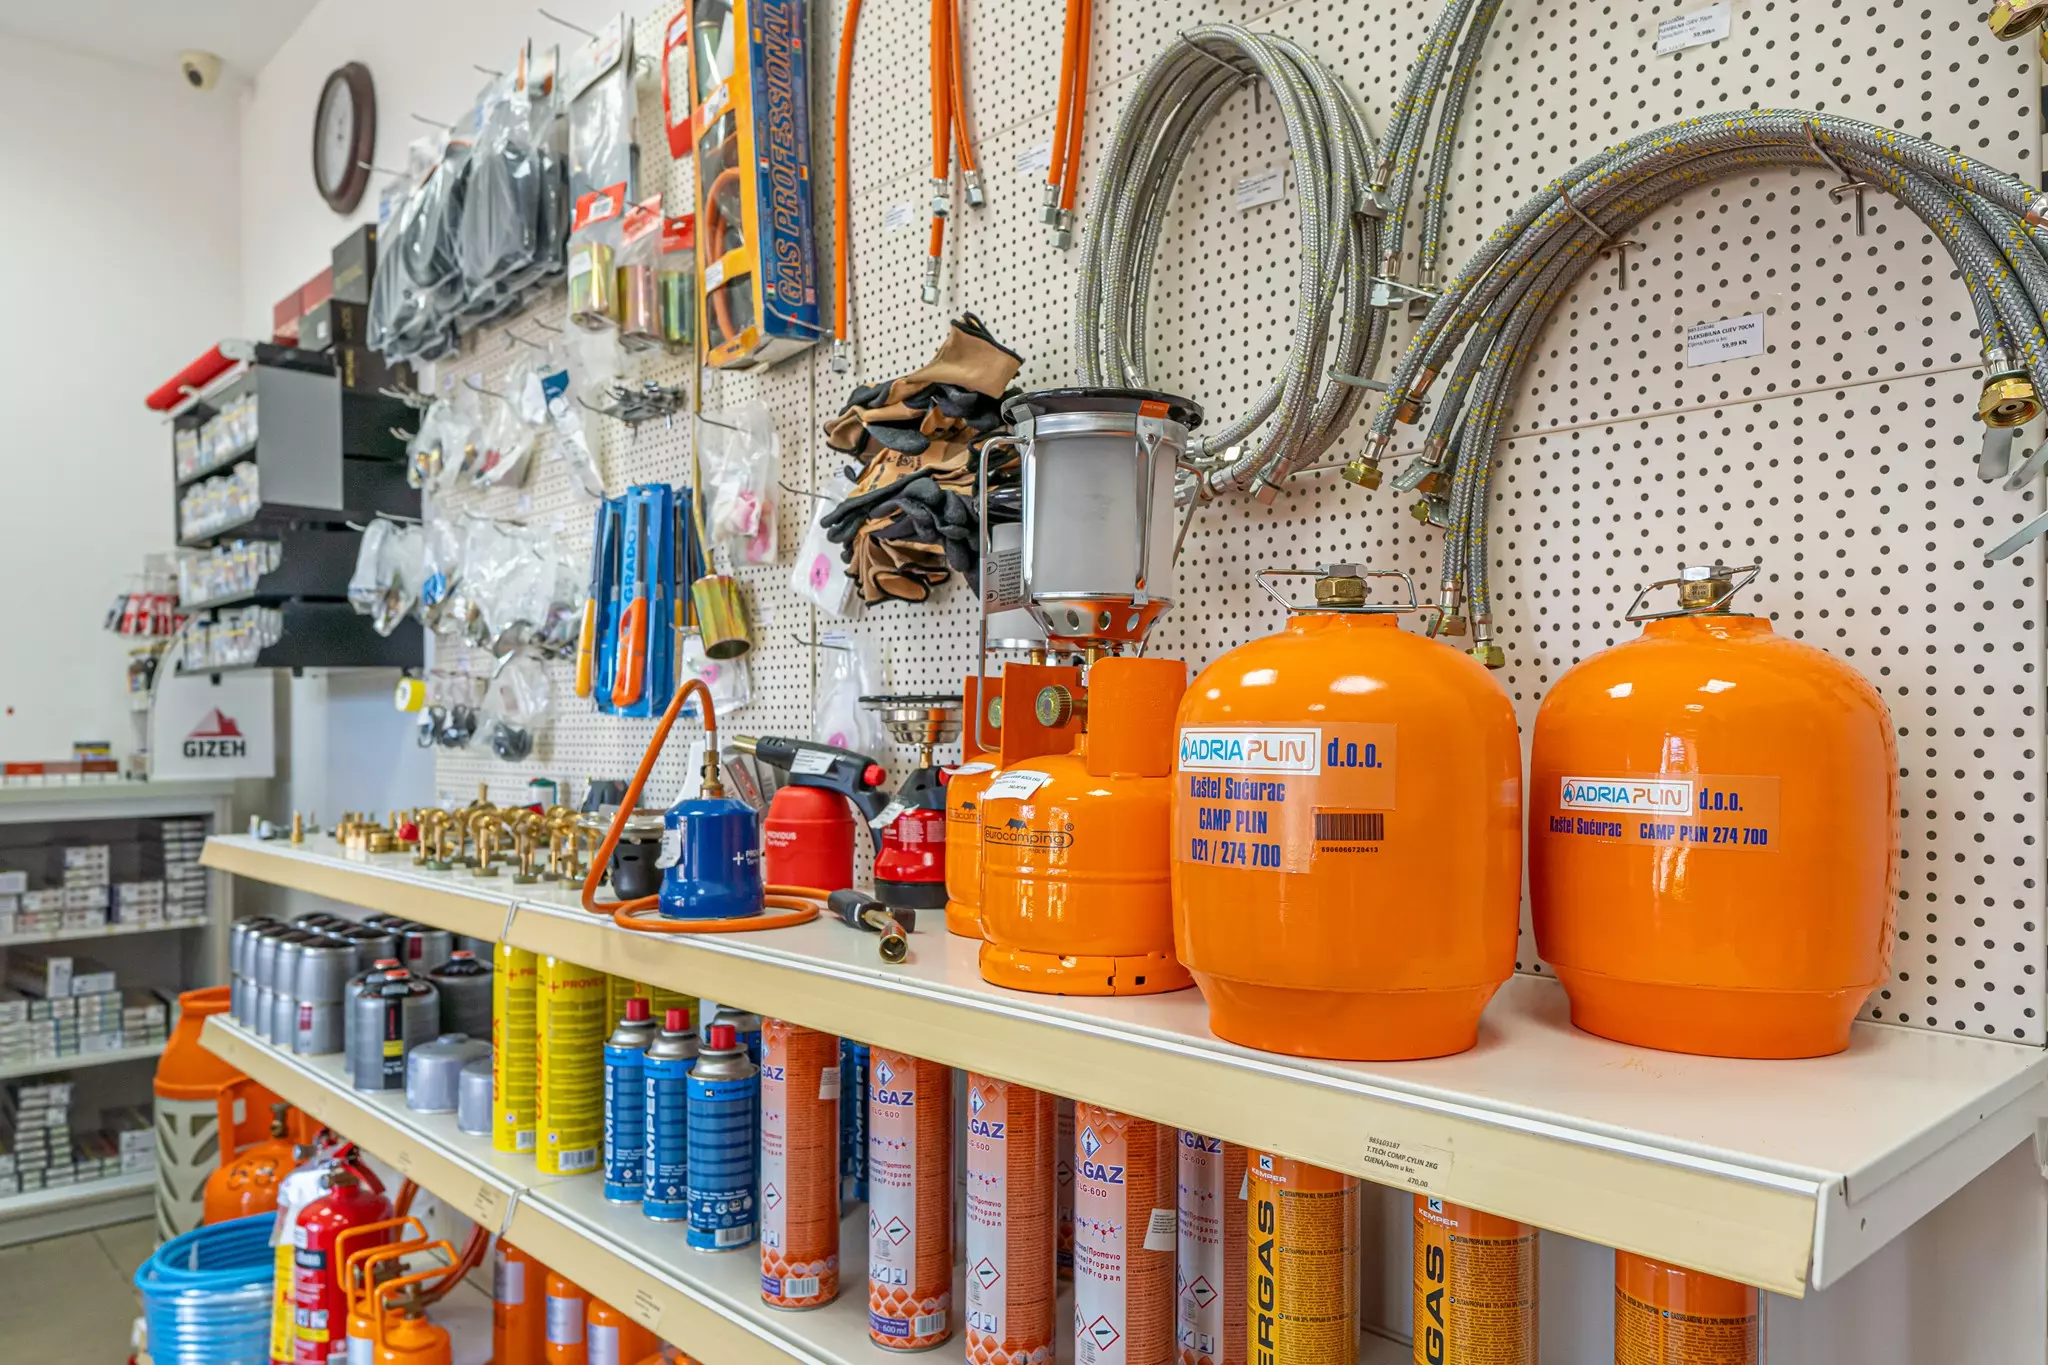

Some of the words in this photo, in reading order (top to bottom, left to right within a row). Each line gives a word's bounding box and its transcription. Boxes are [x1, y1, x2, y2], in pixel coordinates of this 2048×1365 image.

[764, 1, 803, 234] PROFESSIONAL
[777, 237, 804, 307] GAS
[1688, 329, 1720, 341] FLEKSIBILNA
[1738, 322, 1755, 331] 70CM
[1722, 341, 1738, 349] 59,99
[623, 530, 638, 605] GRADO
[183, 739, 246, 758] GIZEH
[1189, 739, 1244, 761] ADRIA
[1247, 739, 1306, 763] PLIN
[1327, 737, 1383, 769] d.o.o.
[1190, 775, 1221, 800] Kaštel
[1225, 777, 1286, 802] Sućurac
[1575, 785, 1630, 804] ADRIA
[1632, 787, 1682, 806] PLIN
[1699, 788, 1744, 812] d.o.o.
[1199, 807, 1232, 832] CAMP
[1235, 810, 1268, 834] PLIN
[1550, 814, 1575, 834] Kaštel
[1577, 816, 1622, 838] Sućurac
[1639, 822, 1675, 841] CAMP
[1679, 825, 1708, 843] PLIN
[1712, 826, 1738, 844] 274
[1743, 827, 1768, 846] 700
[985, 829, 1066, 846] eurocamping
[1191, 838, 1209, 862] 021
[1211, 840, 1218, 865] /
[1221, 841, 1247, 866] 274
[1252, 844, 1281, 868] 700
[604, 1064, 615, 1180] KEMPER
[968, 1118, 1005, 1139] GAZ
[646, 1077, 656, 1197] KEMPER
[1368, 1136, 1400, 1150] 985103187
[1260, 1157, 1270, 1169] K
[1363, 1154, 1399, 1170] CIJENA/kom
[1405, 1166, 1415, 1174] kn:
[1366, 1145, 1387, 1157] T.TECH
[1387, 1151, 1425, 1167] COMP.CYLIN
[1425, 1160, 1439, 1170] 2KG
[1252, 1166, 1287, 1183] KEMPER
[1407, 1176, 1429, 1188] 470,00
[1429, 1199, 1441, 1211] K
[1418, 1207, 1459, 1228] KEMPER
[882, 1324, 896, 1334] 600
[896, 1326, 907, 1336] ml
